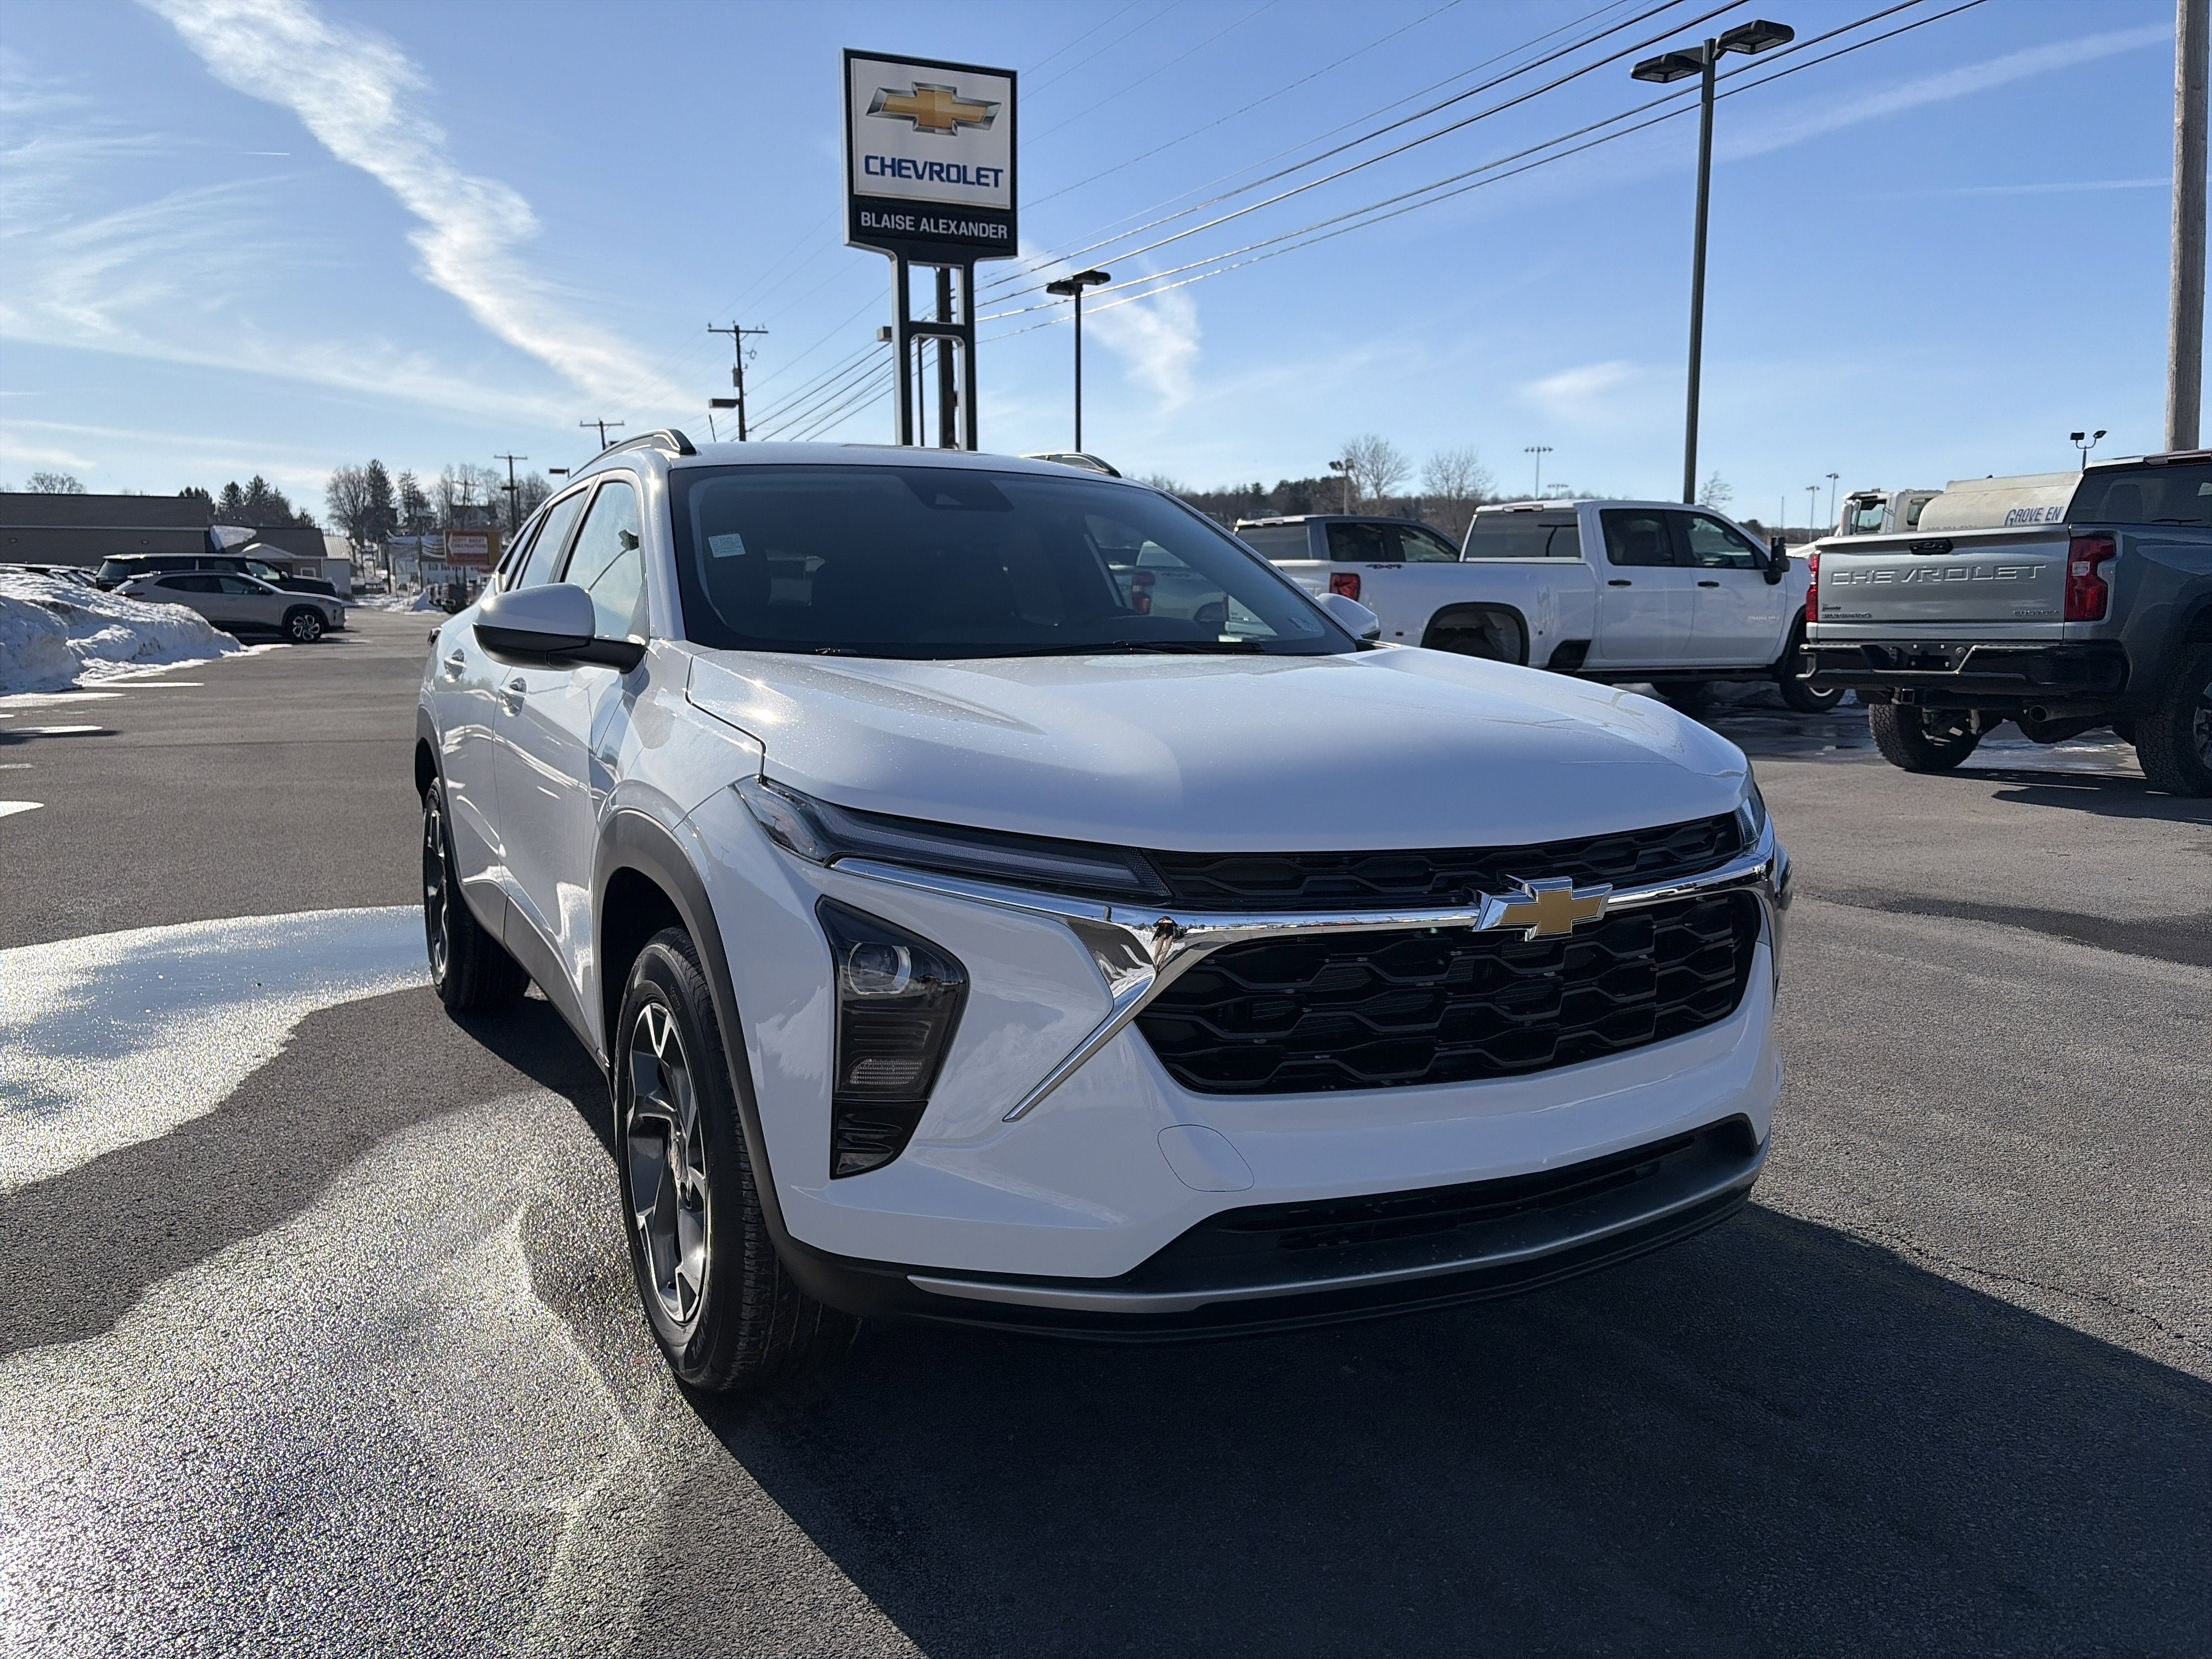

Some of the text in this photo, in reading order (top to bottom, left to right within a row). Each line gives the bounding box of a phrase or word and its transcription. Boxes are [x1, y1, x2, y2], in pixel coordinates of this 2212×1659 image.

[865, 155, 1003, 188] CHEVROLET
[861, 211, 1008, 240] BLAISE ALEXANDER
[2005, 506, 2064, 526] GROVE EN
[1831, 564, 2046, 585] CHEVROLET
